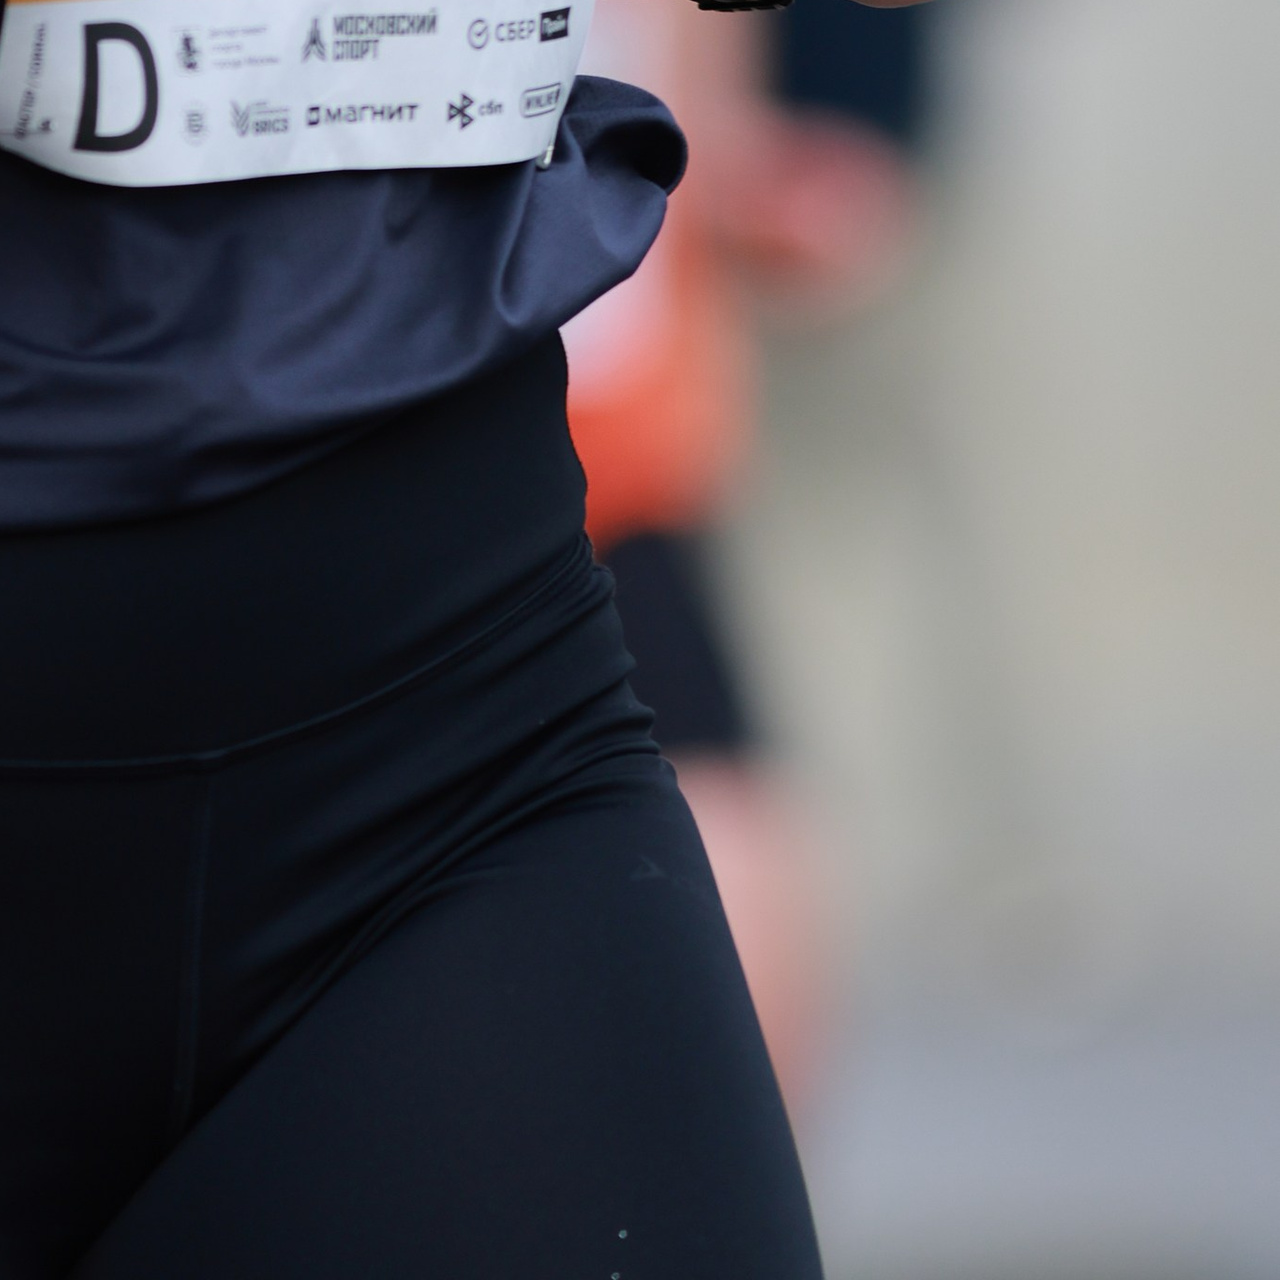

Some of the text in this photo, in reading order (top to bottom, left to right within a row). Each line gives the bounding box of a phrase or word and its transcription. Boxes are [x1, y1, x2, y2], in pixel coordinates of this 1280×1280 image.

[333, 8, 438, 36] МОСКОВСКИЙ
[495, 18, 536, 42] СБЕР
[333, 39, 380, 62] СПОРТ
[73, 21, 158, 153] D
